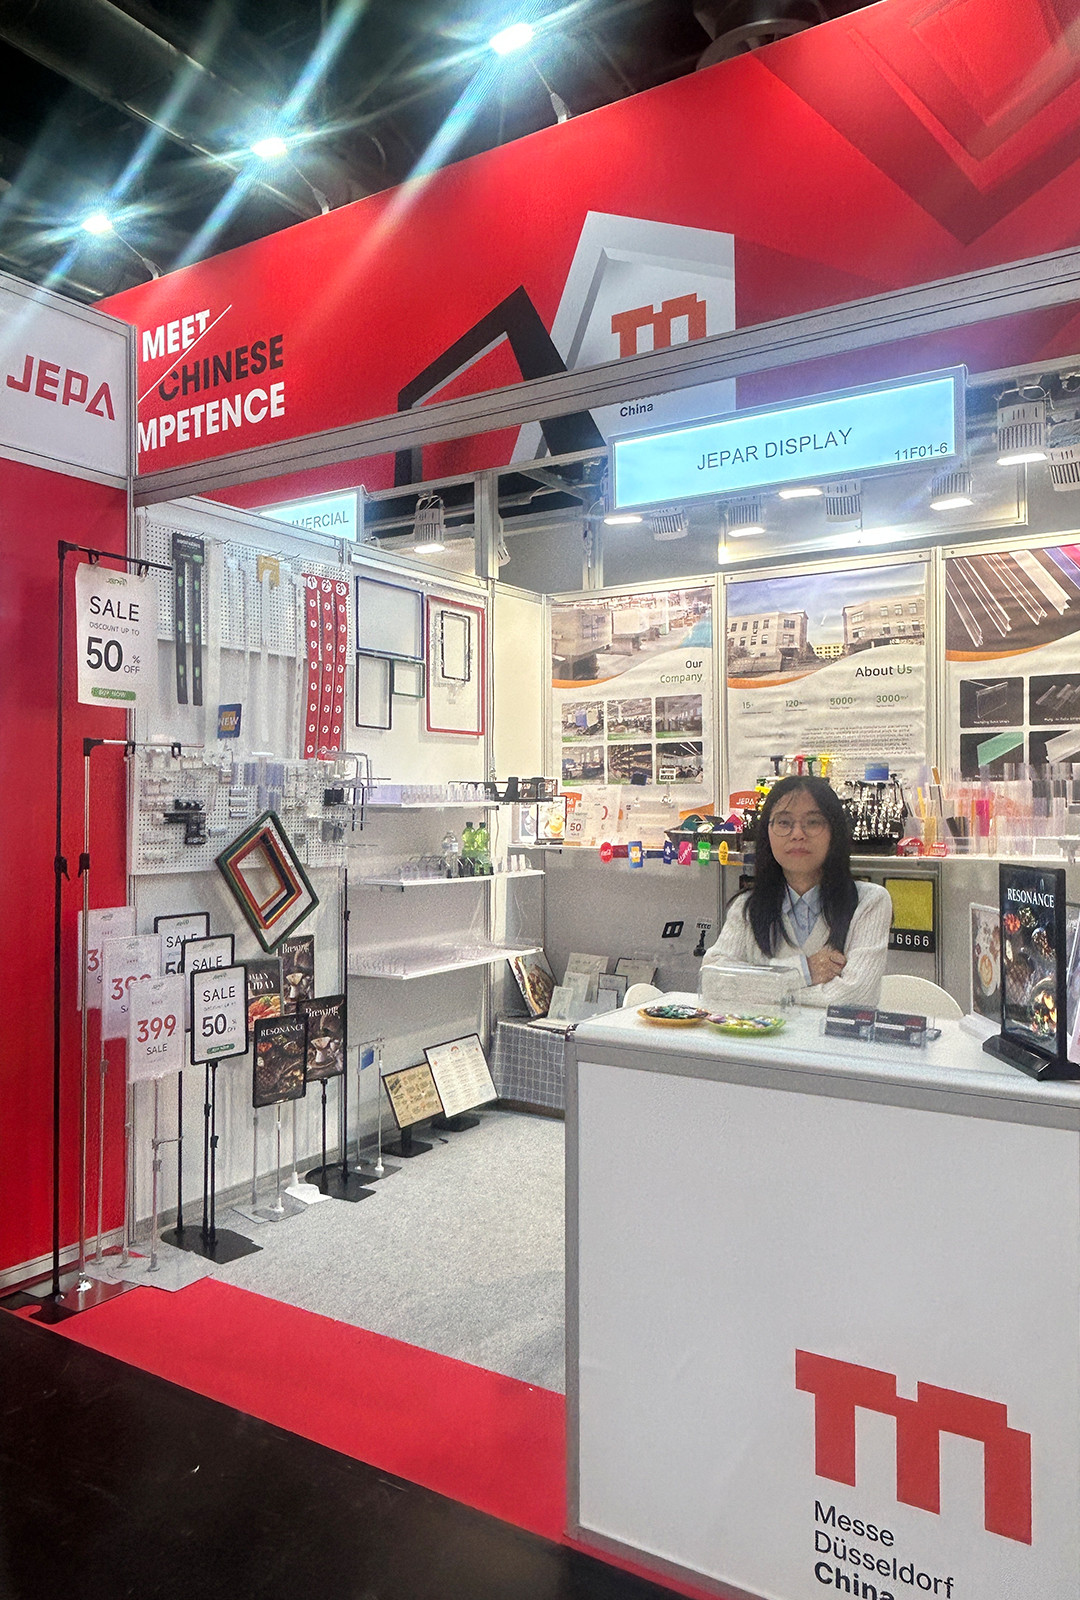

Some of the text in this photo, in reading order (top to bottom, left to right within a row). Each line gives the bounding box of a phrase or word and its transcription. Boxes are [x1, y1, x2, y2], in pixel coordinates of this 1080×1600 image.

[142, 309, 210, 362] MEET
[159, 335, 284, 402] CHINESE
[6, 355, 116, 421] JEPA
[620, 401, 654, 417] China
[697, 427, 853, 471] JEPAR DISPLAY
[894, 442, 949, 461] 11F01-6
[89, 596, 140, 622] SALE
[89, 621, 140, 636] DISCOUNT UP TO
[86, 636, 123, 673] 50
[124, 664, 141, 674] OFF
[685, 660, 703, 669] Our
[855, 664, 913, 678] About Us
[660, 672, 703, 684] Company
[570, 822, 582, 831] 50
[1007, 887, 1055, 908] RESONANCE
[282, 943, 310, 954] Brewing
[896, 933, 930, 947] 6666
[192, 955, 223, 972] SALE
[203, 986, 236, 1003] SALE
[305, 1006, 339, 1017] Brewing
[137, 1014, 177, 1044] 399
[201, 1013, 227, 1038] 50
[260, 1023, 305, 1037] RESONANCE
[146, 1043, 168, 1056] SALE
[814, 1500, 895, 1547] Messe
[814, 1529, 954, 1599] Düsseldorf
